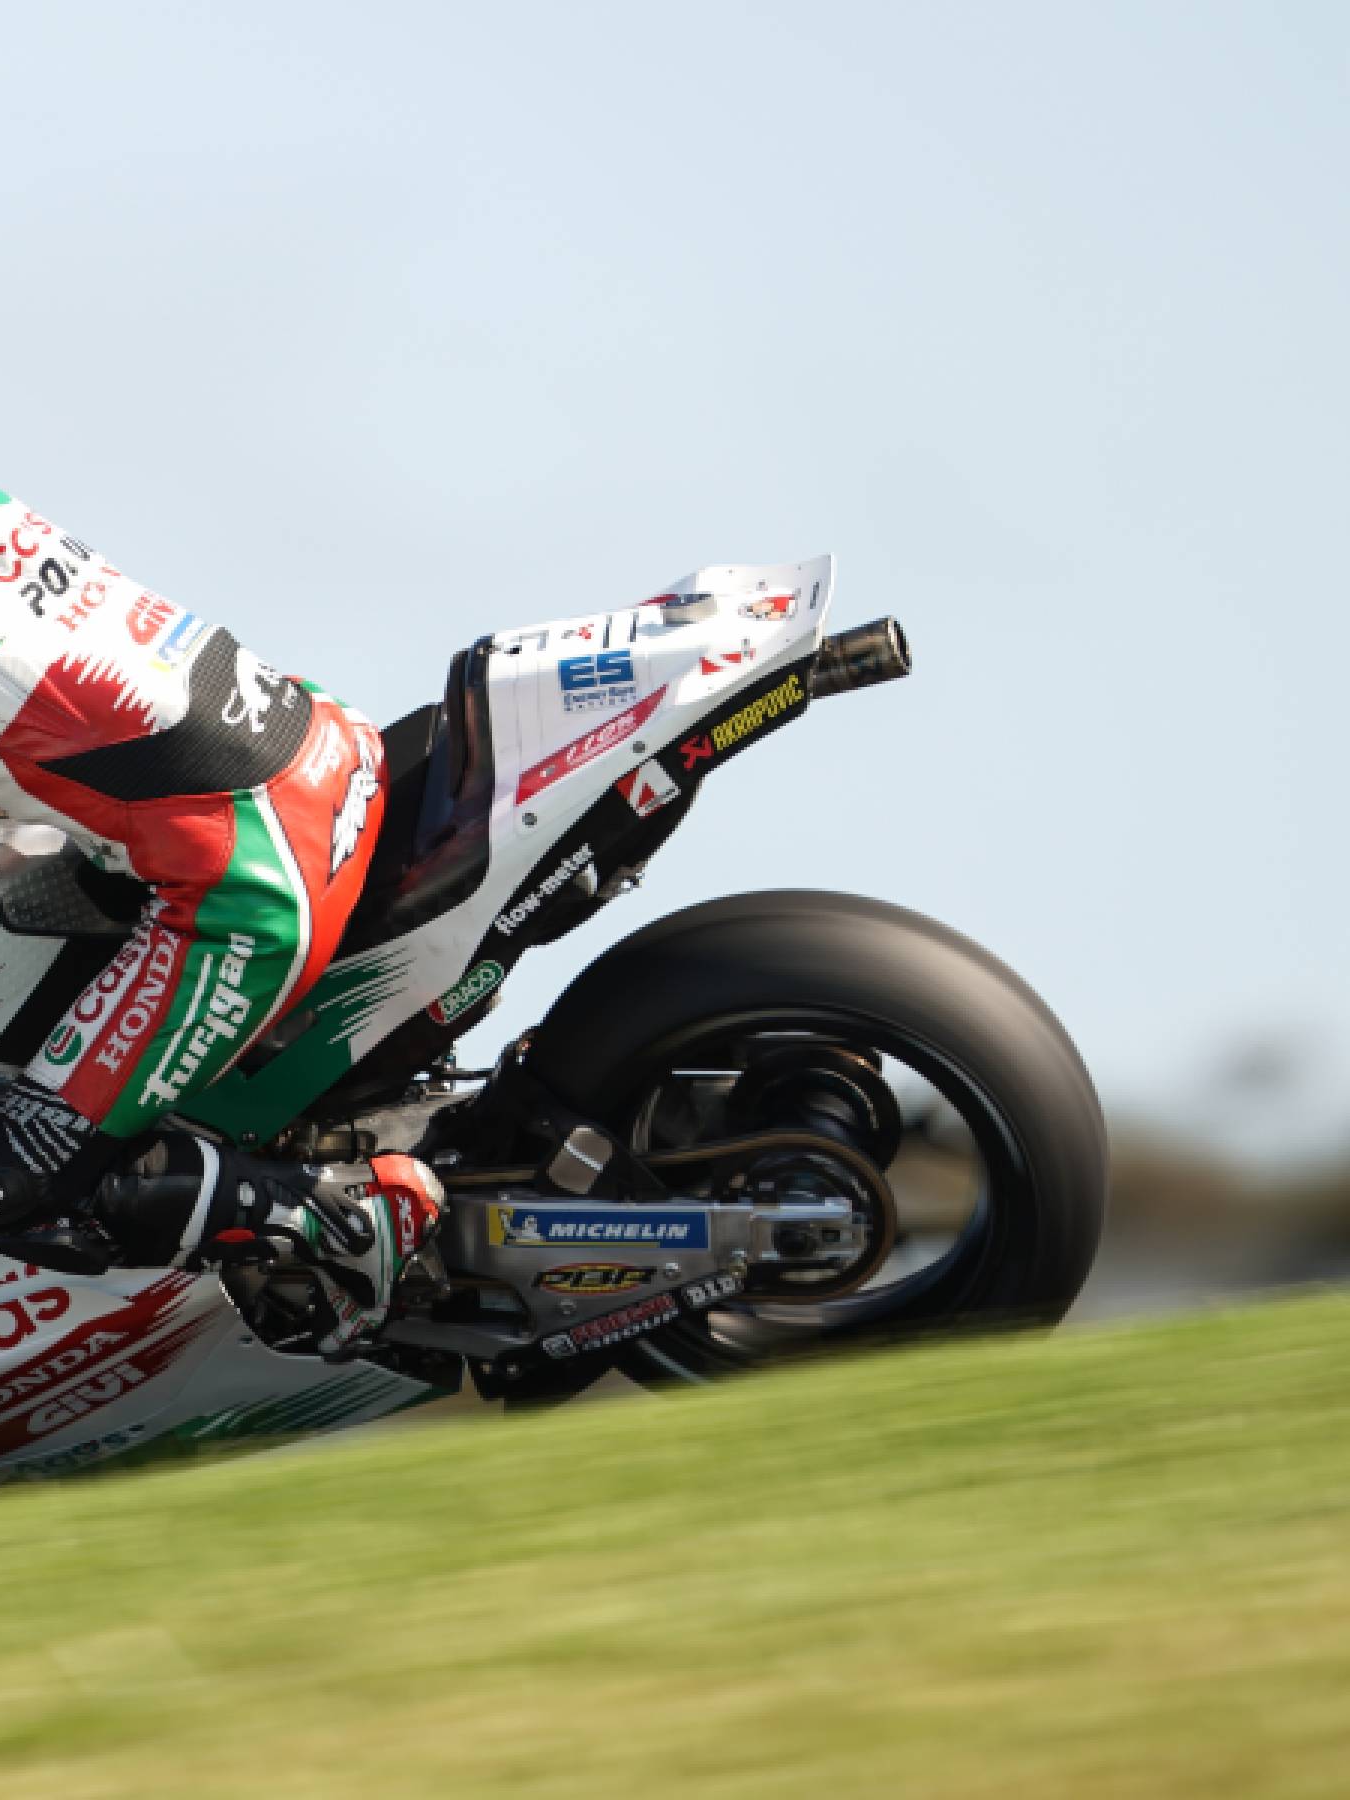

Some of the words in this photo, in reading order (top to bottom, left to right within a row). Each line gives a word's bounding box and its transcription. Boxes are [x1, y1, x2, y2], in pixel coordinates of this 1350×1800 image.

[557, 648, 636, 691] ES
[137, 933, 256, 1108] Furygan
[548, 1222, 691, 1240] MICHELIN
[26, 1360, 150, 1435] GIVI
